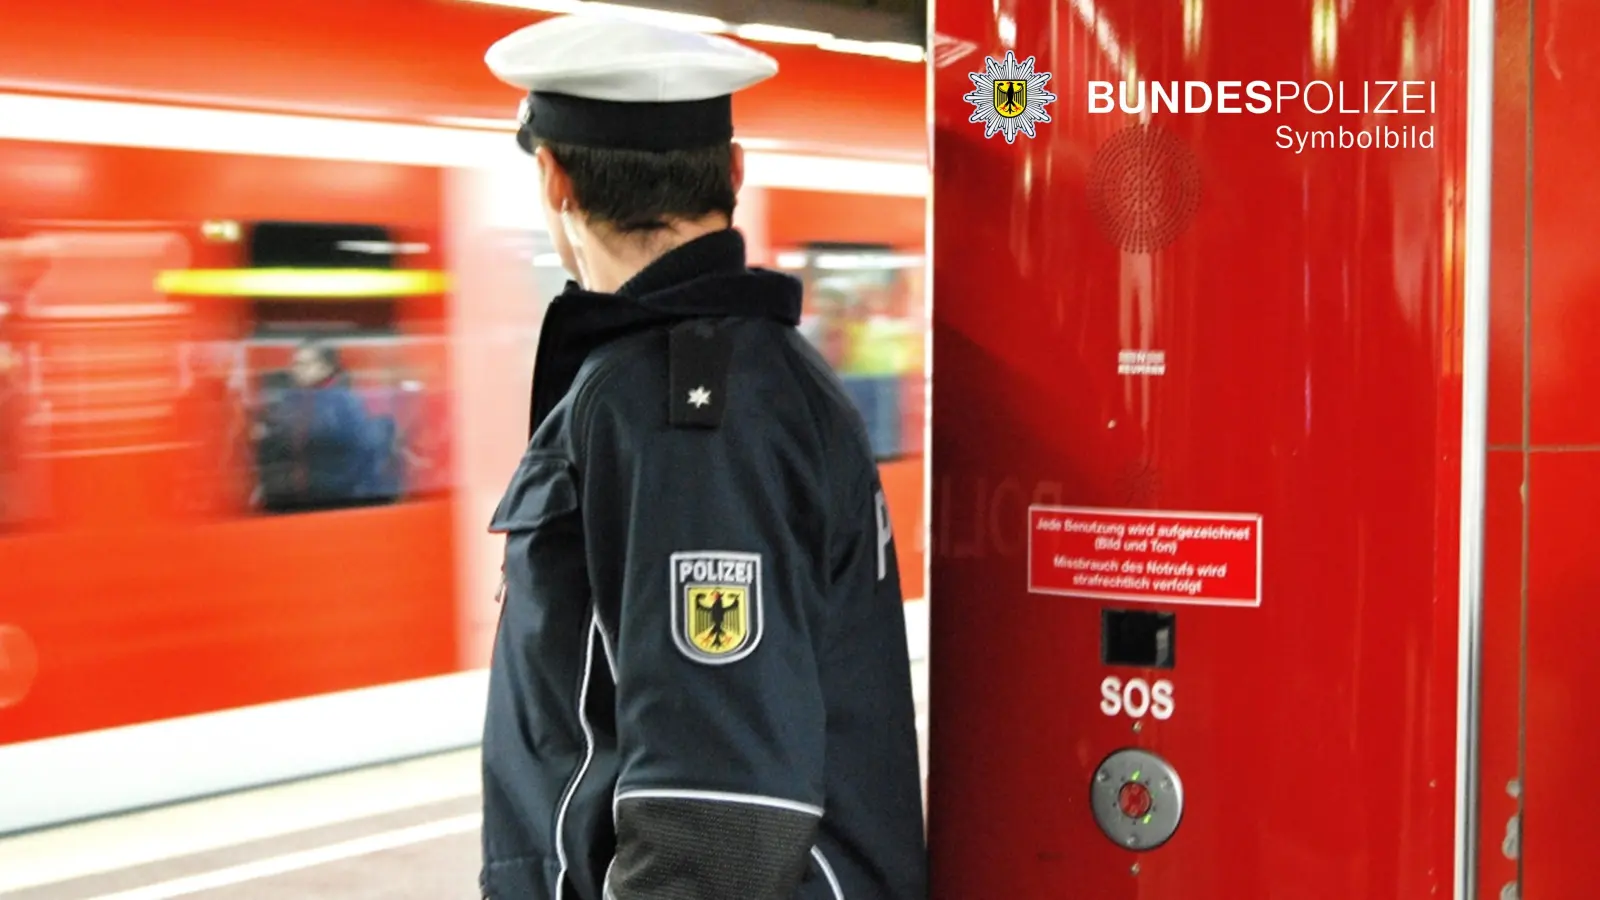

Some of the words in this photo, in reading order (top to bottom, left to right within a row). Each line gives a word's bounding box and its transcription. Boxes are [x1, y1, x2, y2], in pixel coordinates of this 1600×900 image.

[1036, 518, 1062, 532] Jede
[1064, 518, 1125, 537] Benutzung
[1128, 522, 1155, 537] wird
[1158, 523, 1250, 541] aufgezeichnet
[1094, 537, 1122, 551] (Bild
[1124, 539, 1147, 552] und
[1150, 539, 1178, 556] Ton)
[679, 560, 753, 585] POLIZEI
[1054, 555, 1118, 572] Missbrauch
[1121, 560, 1143, 574] des
[1146, 560, 1194, 577] Notrufs
[1197, 563, 1228, 578] wird
[1073, 573, 1150, 590] strafrechtlich
[1153, 577, 1203, 595] verfolgt
[1100, 676, 1175, 720] SOS
